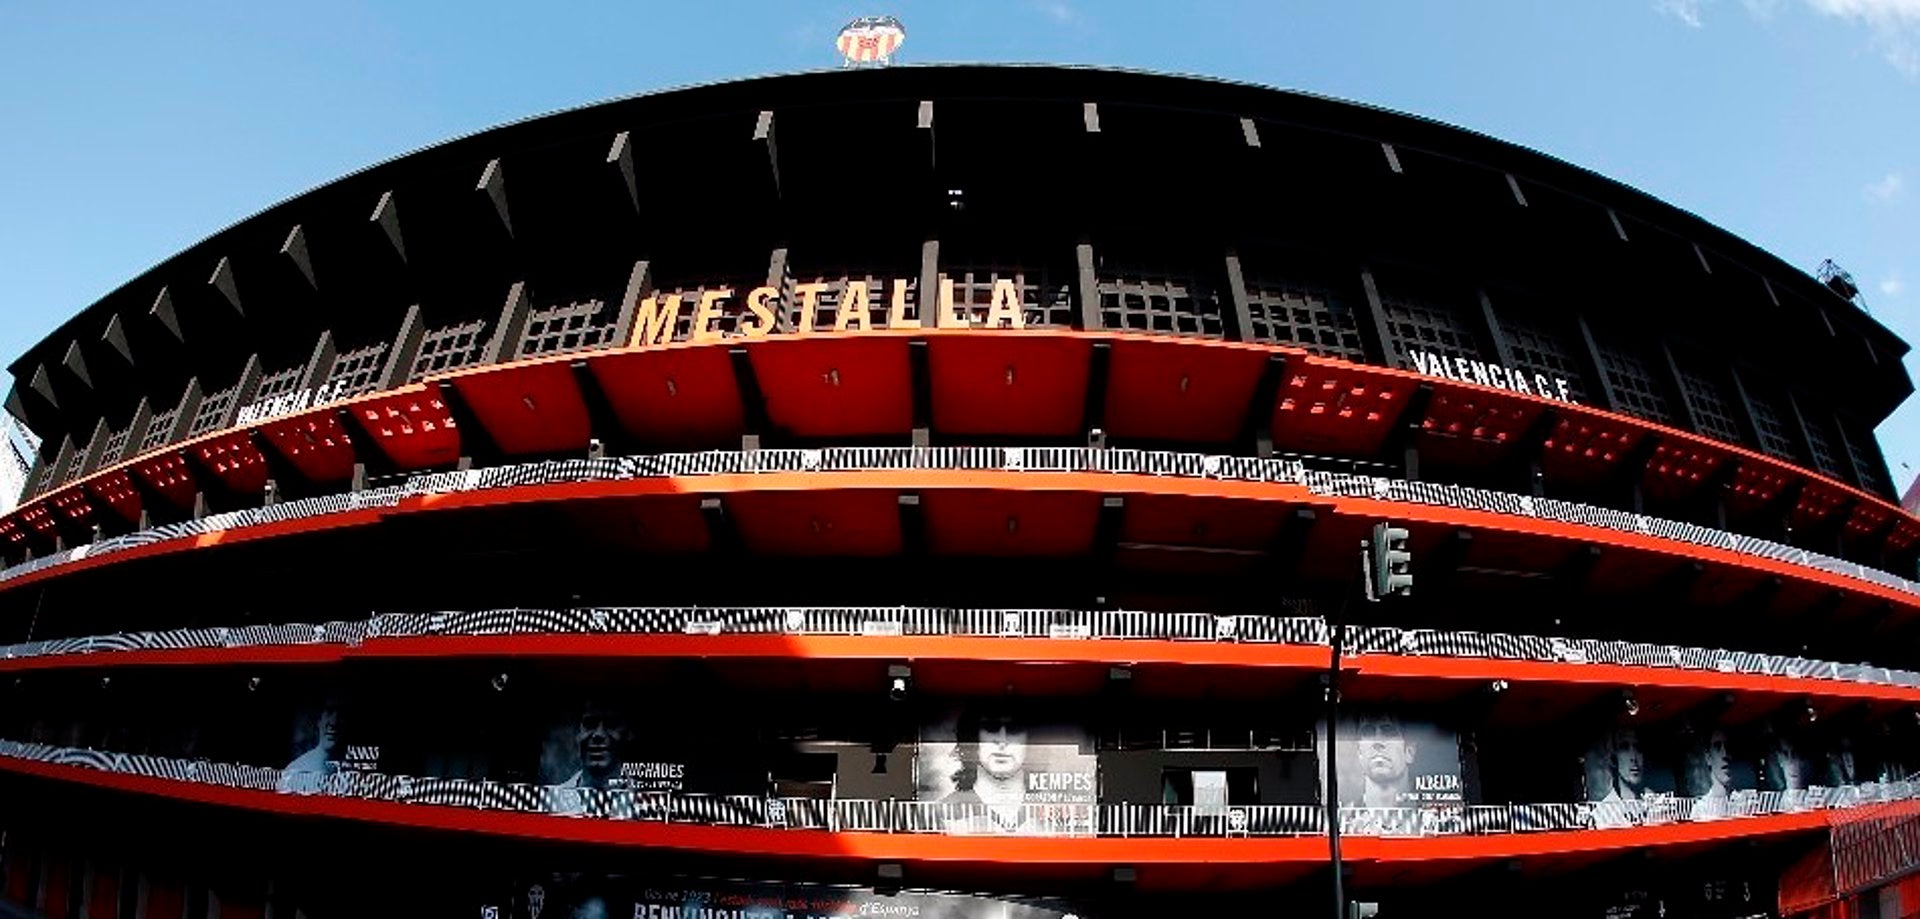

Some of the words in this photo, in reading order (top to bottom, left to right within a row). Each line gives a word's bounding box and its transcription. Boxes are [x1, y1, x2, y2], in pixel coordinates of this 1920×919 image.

[630, 278, 1025, 348] MESTALLA
[1409, 350, 1533, 397] VALENCIA
[235, 388, 313, 426] VALENCIA
[1028, 772, 1093, 791] KEMPES
